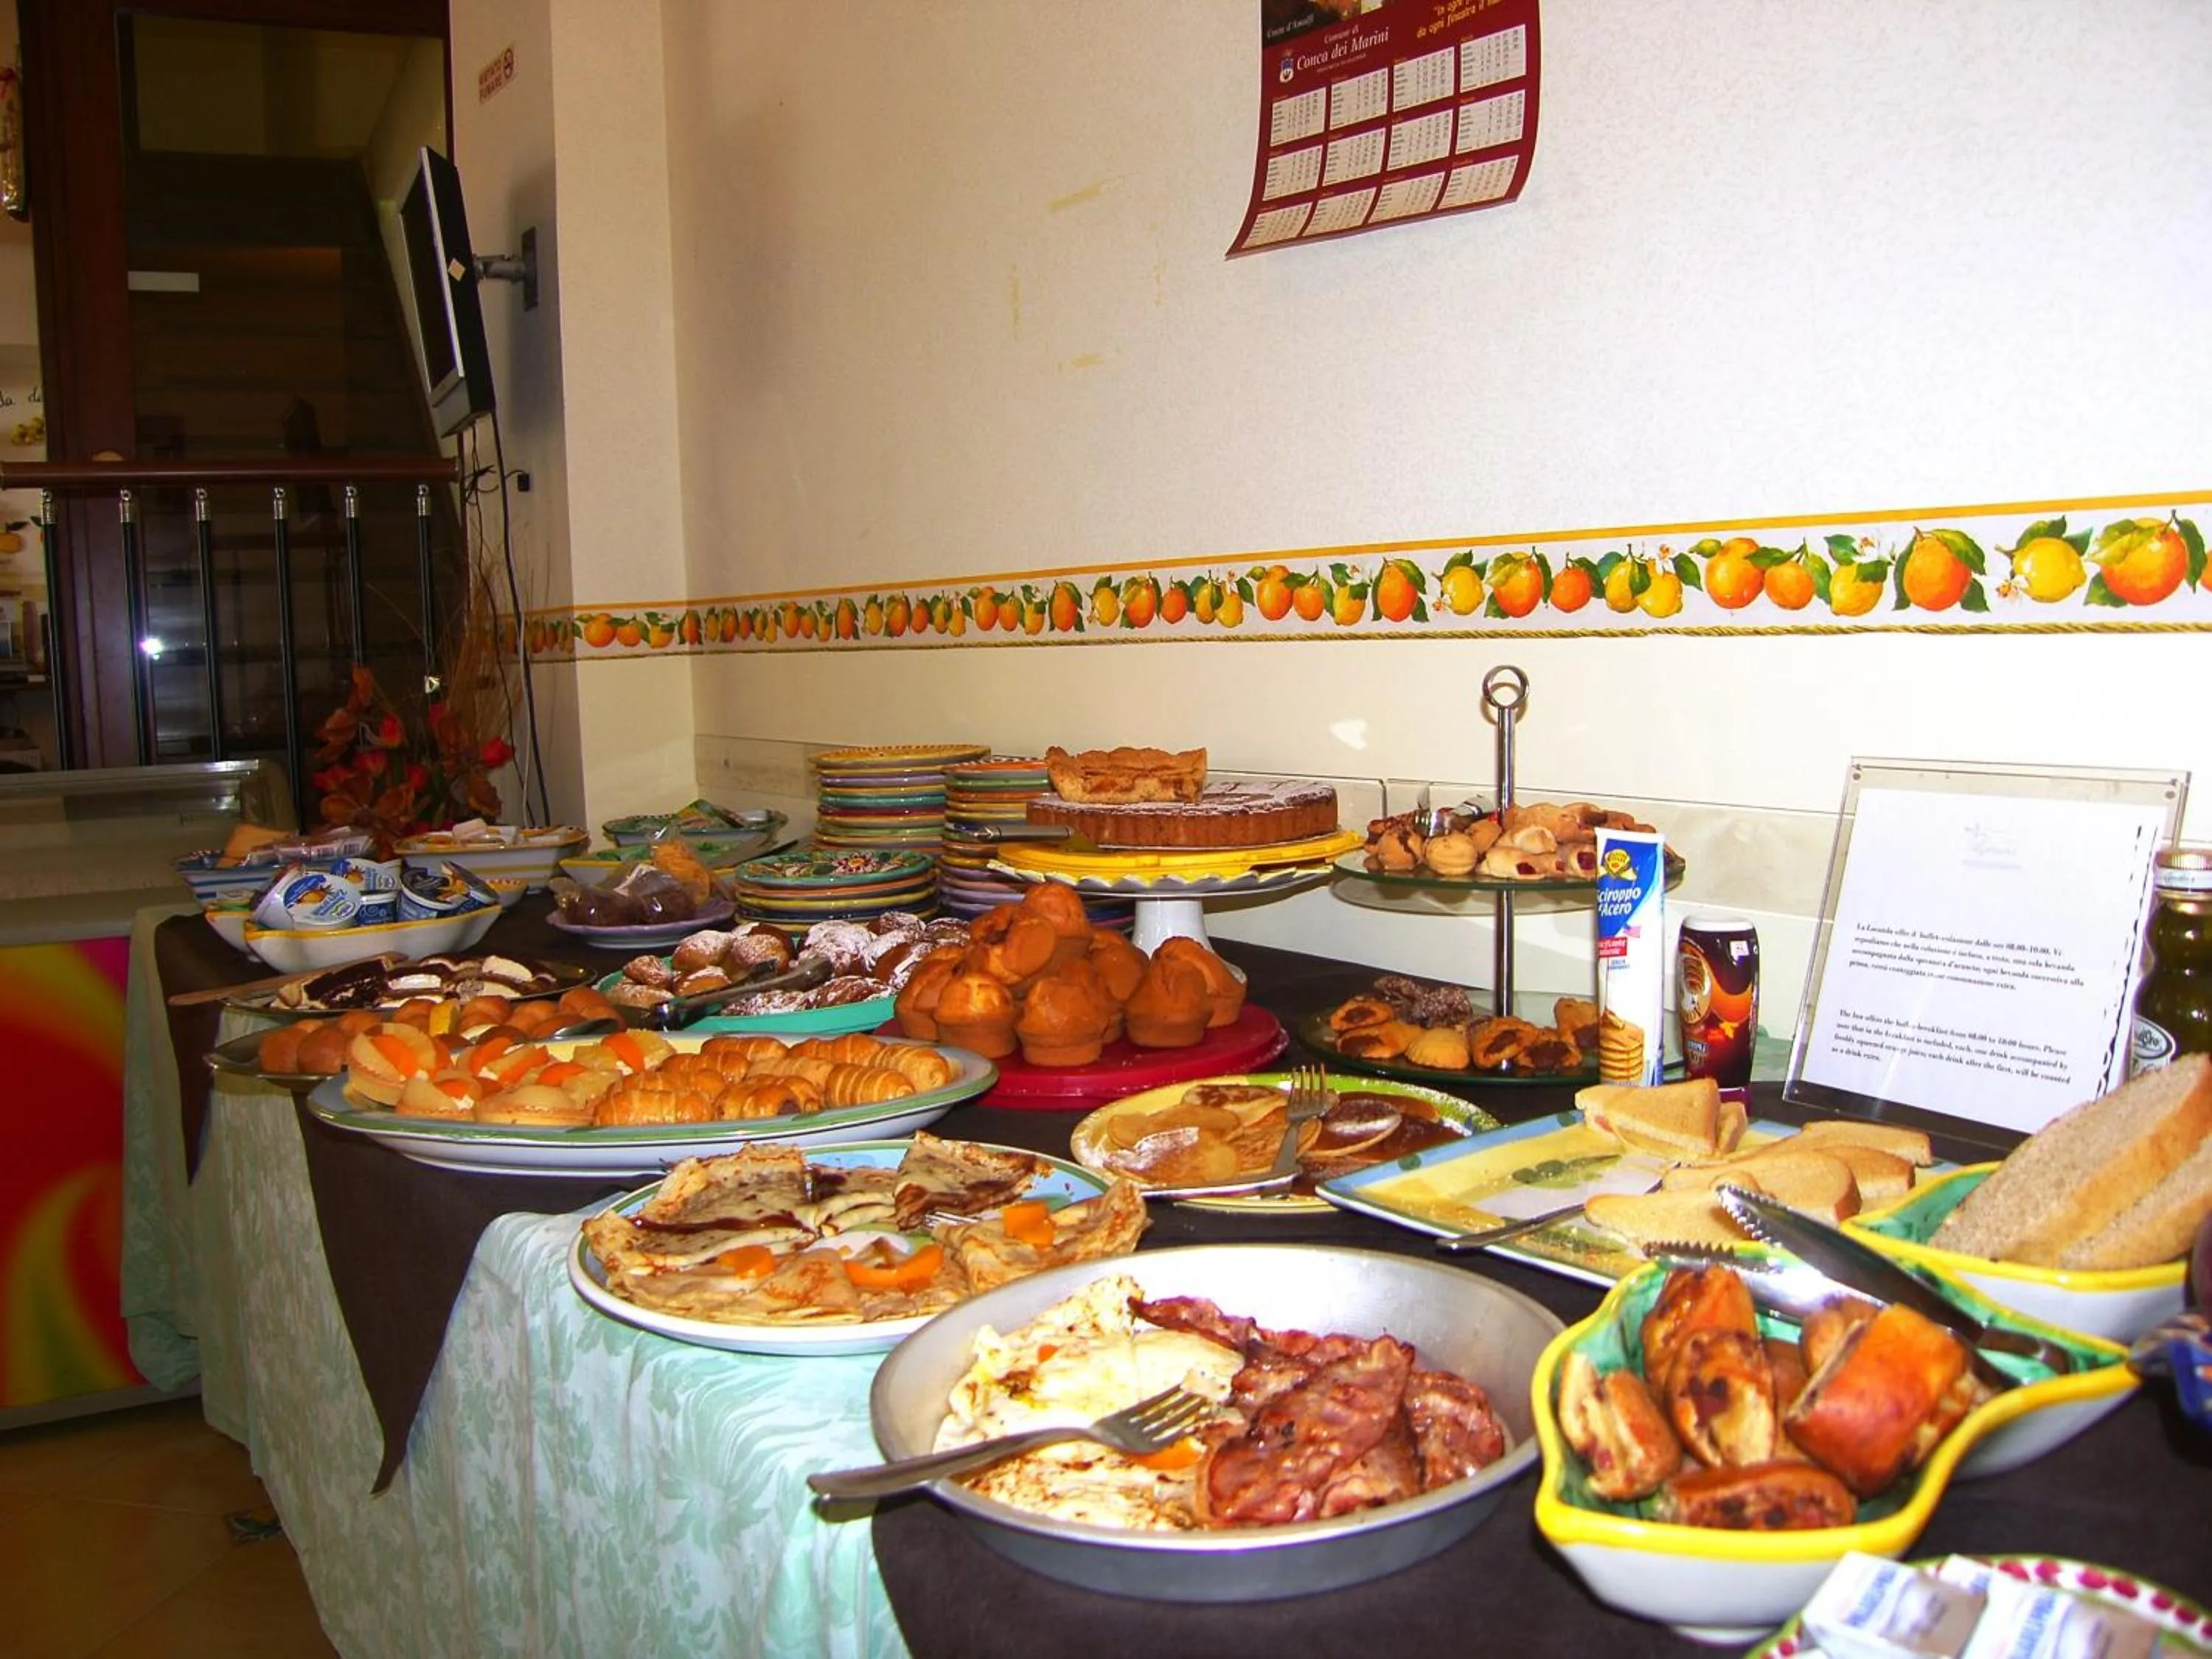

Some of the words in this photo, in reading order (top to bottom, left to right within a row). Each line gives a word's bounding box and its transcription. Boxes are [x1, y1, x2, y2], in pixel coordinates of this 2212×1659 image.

[1297, 50, 1328, 70] Conca
[1331, 41, 1348, 59] dei
[1351, 27, 1390, 52] Marini
